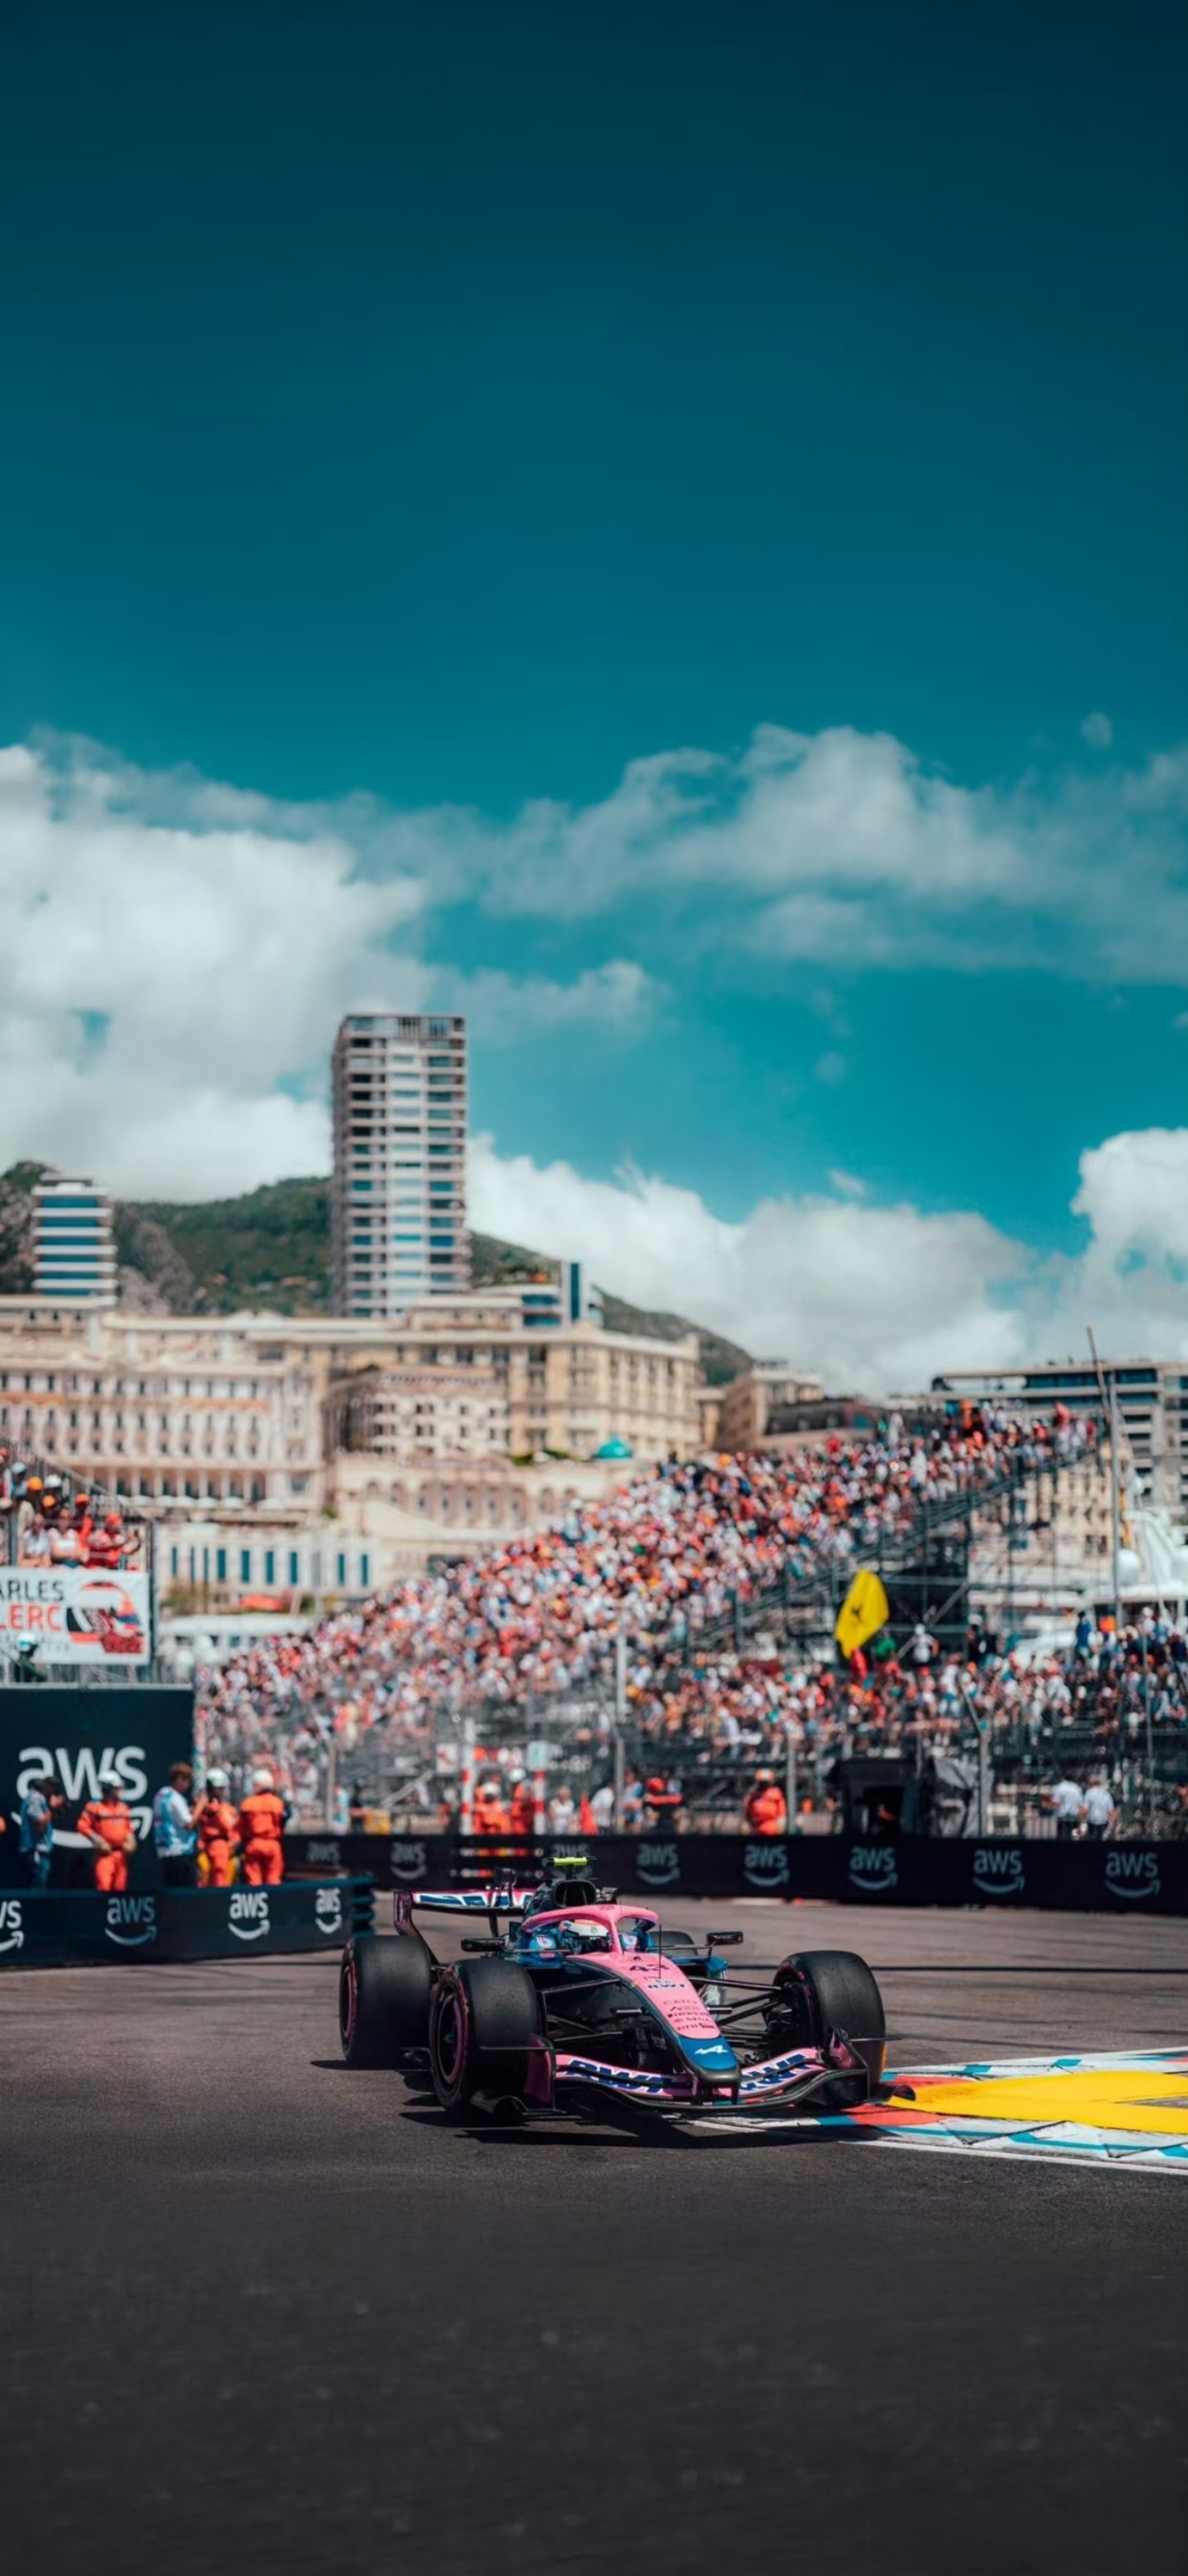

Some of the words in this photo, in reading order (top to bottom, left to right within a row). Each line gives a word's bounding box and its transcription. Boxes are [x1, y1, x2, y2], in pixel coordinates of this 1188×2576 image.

[17, 1746, 148, 1801] aws
[637, 1843, 679, 1867] aws
[745, 1844, 788, 1868] aws
[850, 1846, 896, 1871] aws
[973, 1849, 1022, 1874] aws
[1105, 1852, 1159, 1878] aws
[106, 1897, 155, 1925] aws
[230, 1892, 268, 1920] aws
[315, 1888, 341, 1914] aws
